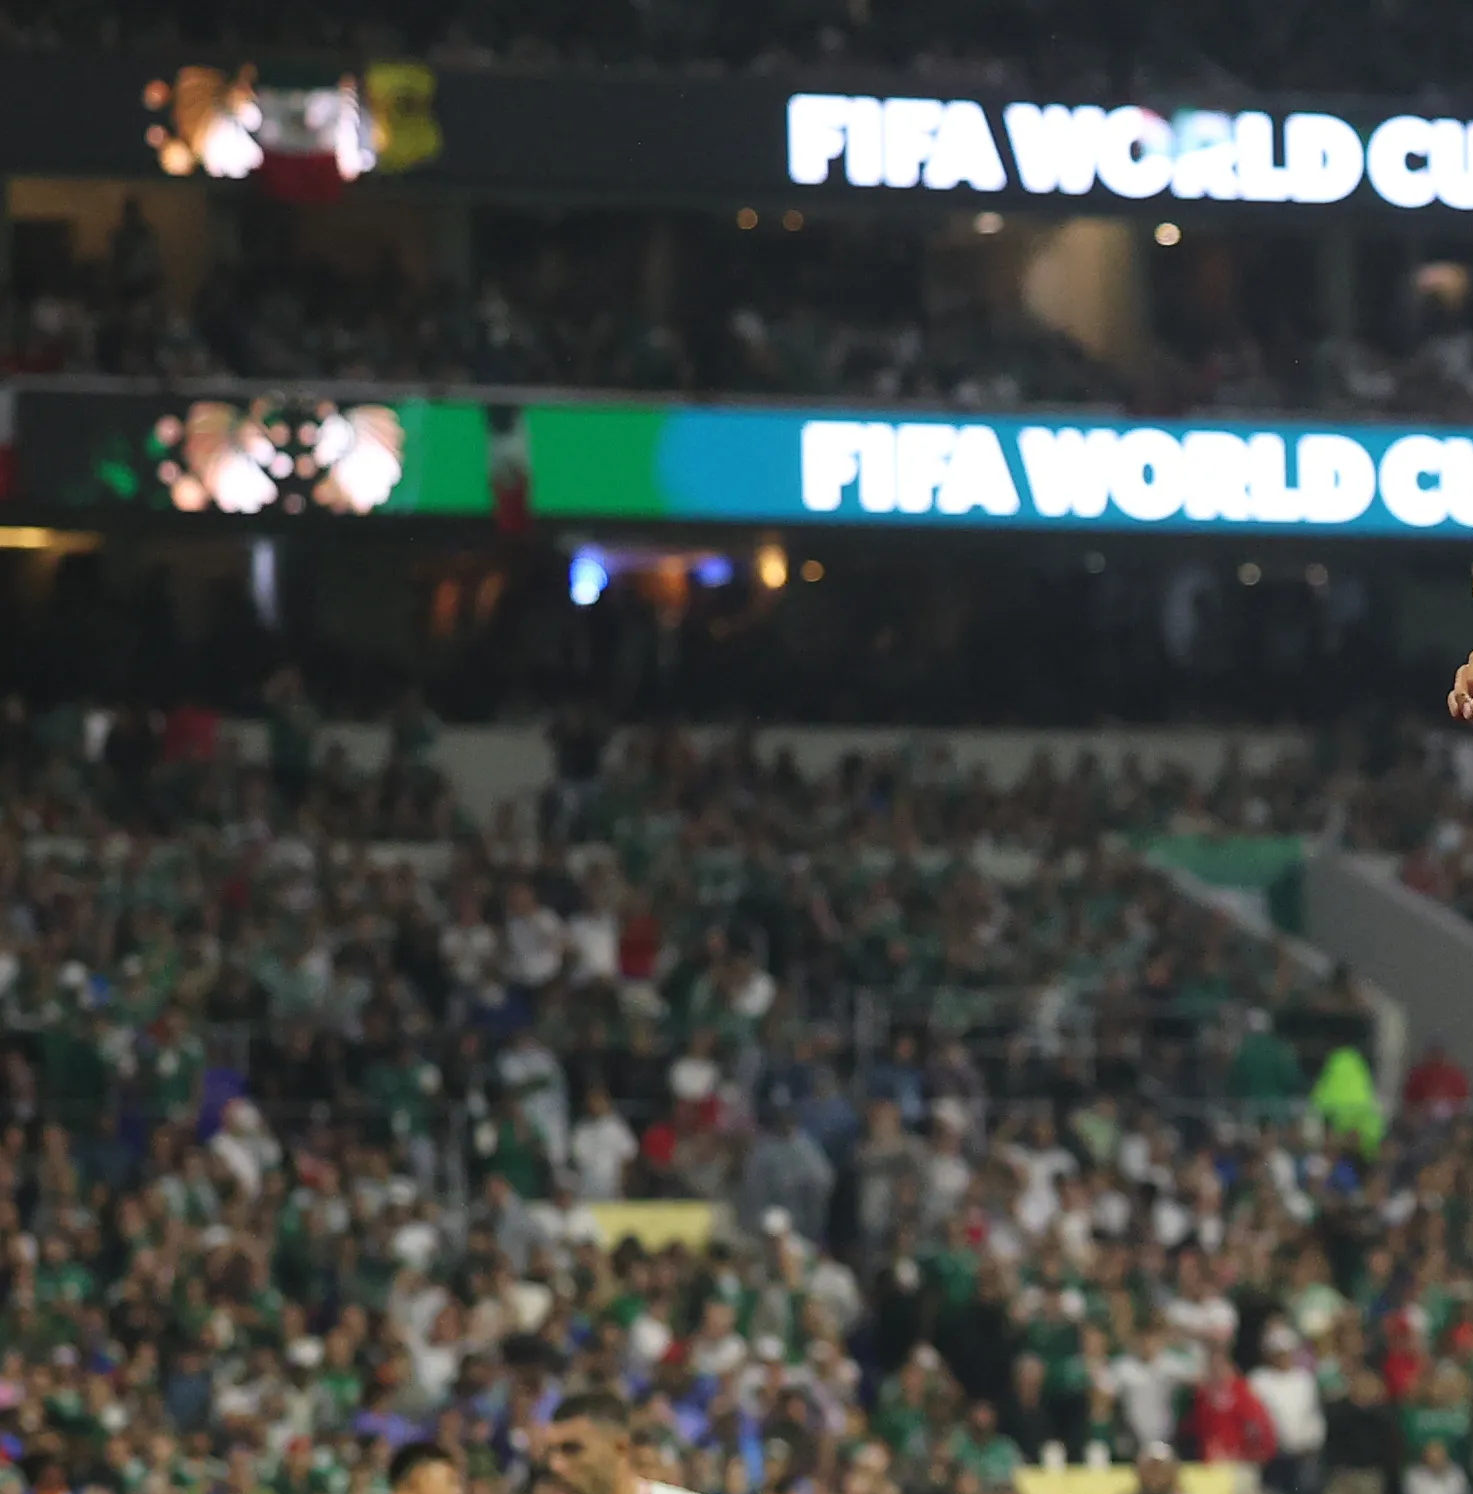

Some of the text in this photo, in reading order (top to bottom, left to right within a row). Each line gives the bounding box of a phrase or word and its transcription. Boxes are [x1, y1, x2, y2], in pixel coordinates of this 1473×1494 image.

[787, 93, 1006, 191] FIFA
[1003, 102, 1364, 203] WORLD
[801, 420, 1020, 515] FIFA
[1018, 427, 1376, 524] WORLD
